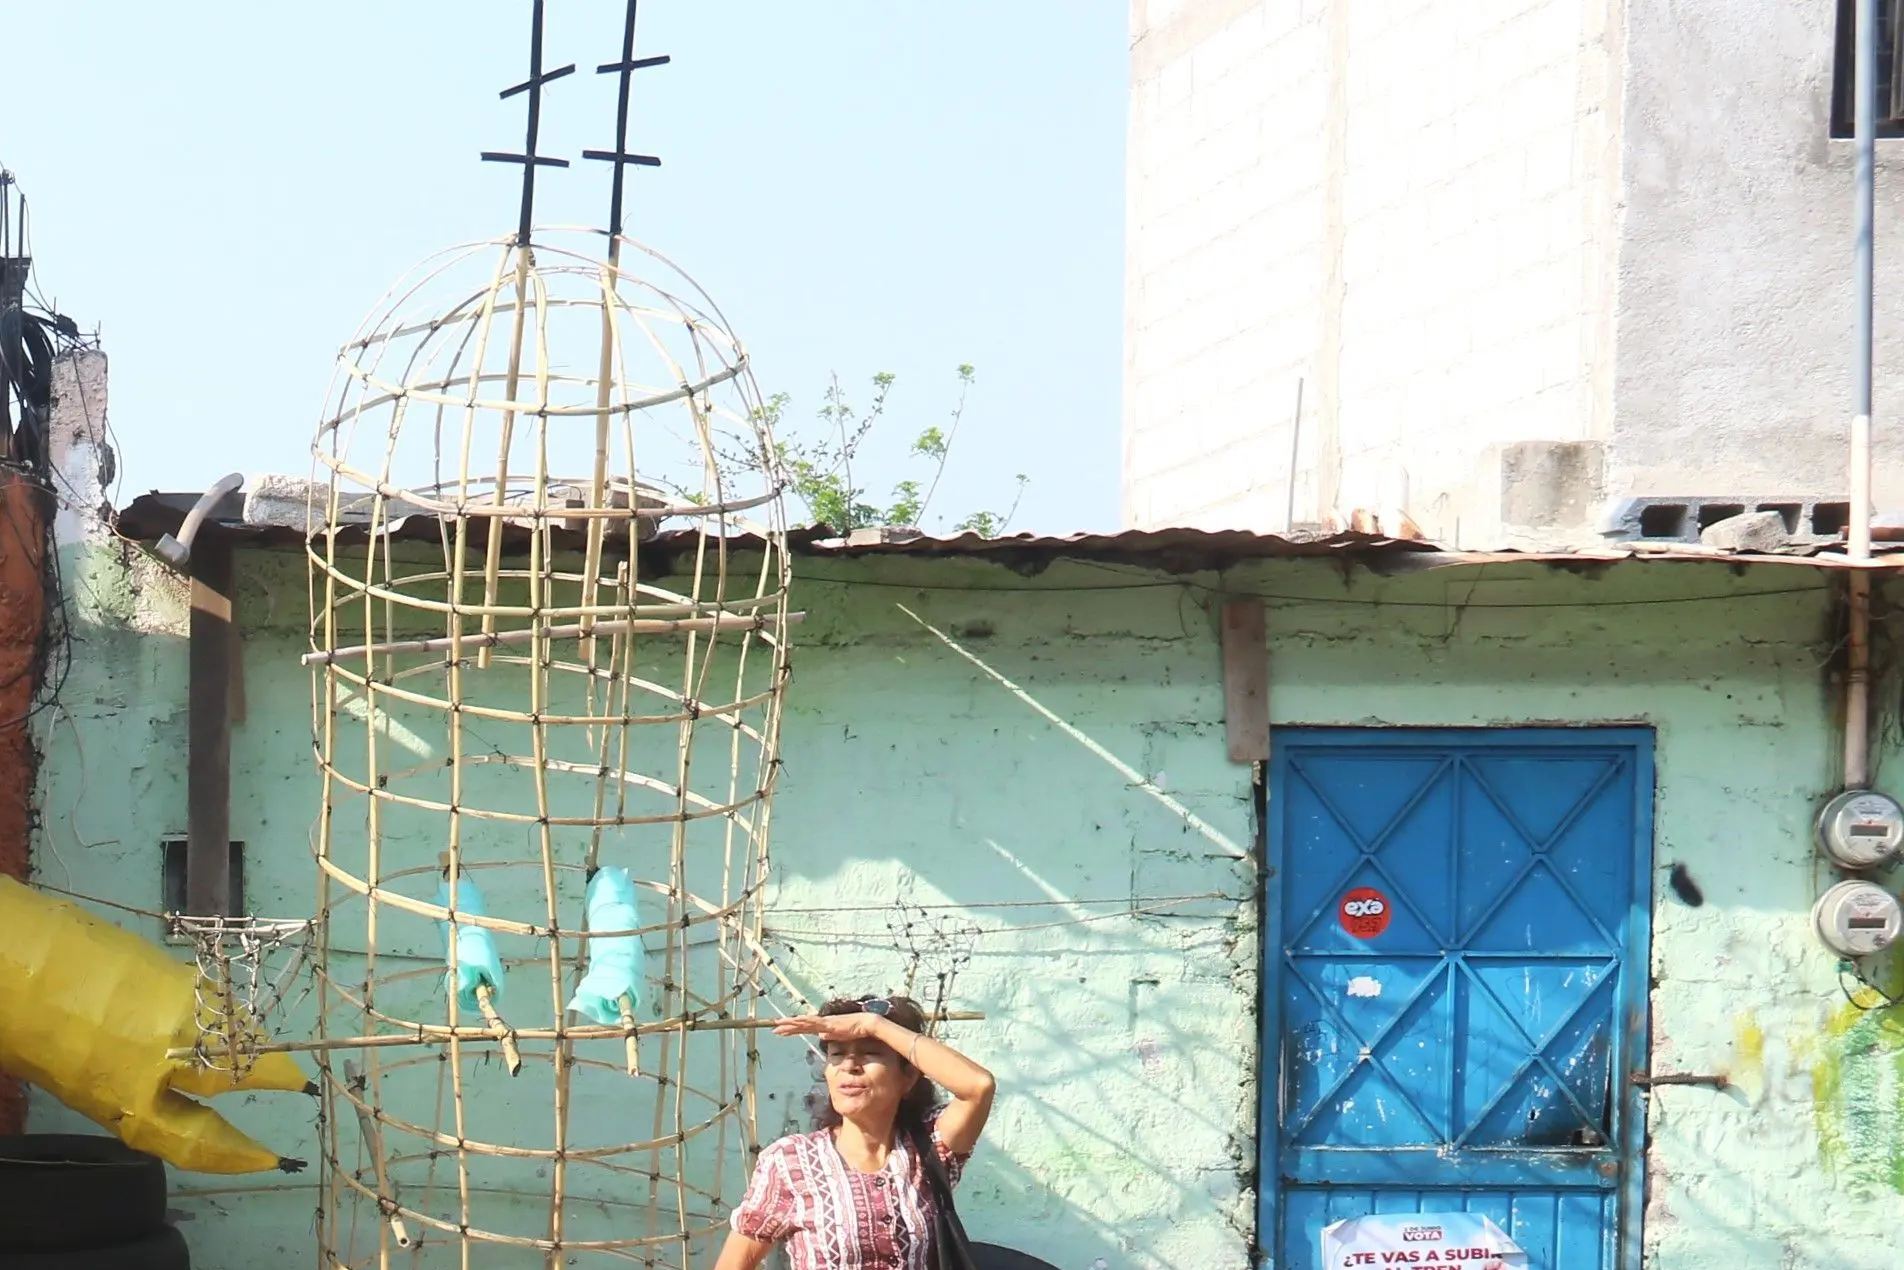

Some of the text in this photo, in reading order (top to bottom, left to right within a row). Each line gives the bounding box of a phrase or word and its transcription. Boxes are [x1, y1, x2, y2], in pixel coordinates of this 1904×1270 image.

[1344, 898, 1384, 917] exa
[1405, 1231, 1441, 1240] VOTA
[1343, 1253, 1376, 1267] ¿TE
[1381, 1251, 1419, 1263] VAS
[1425, 1250, 1440, 1261] A
